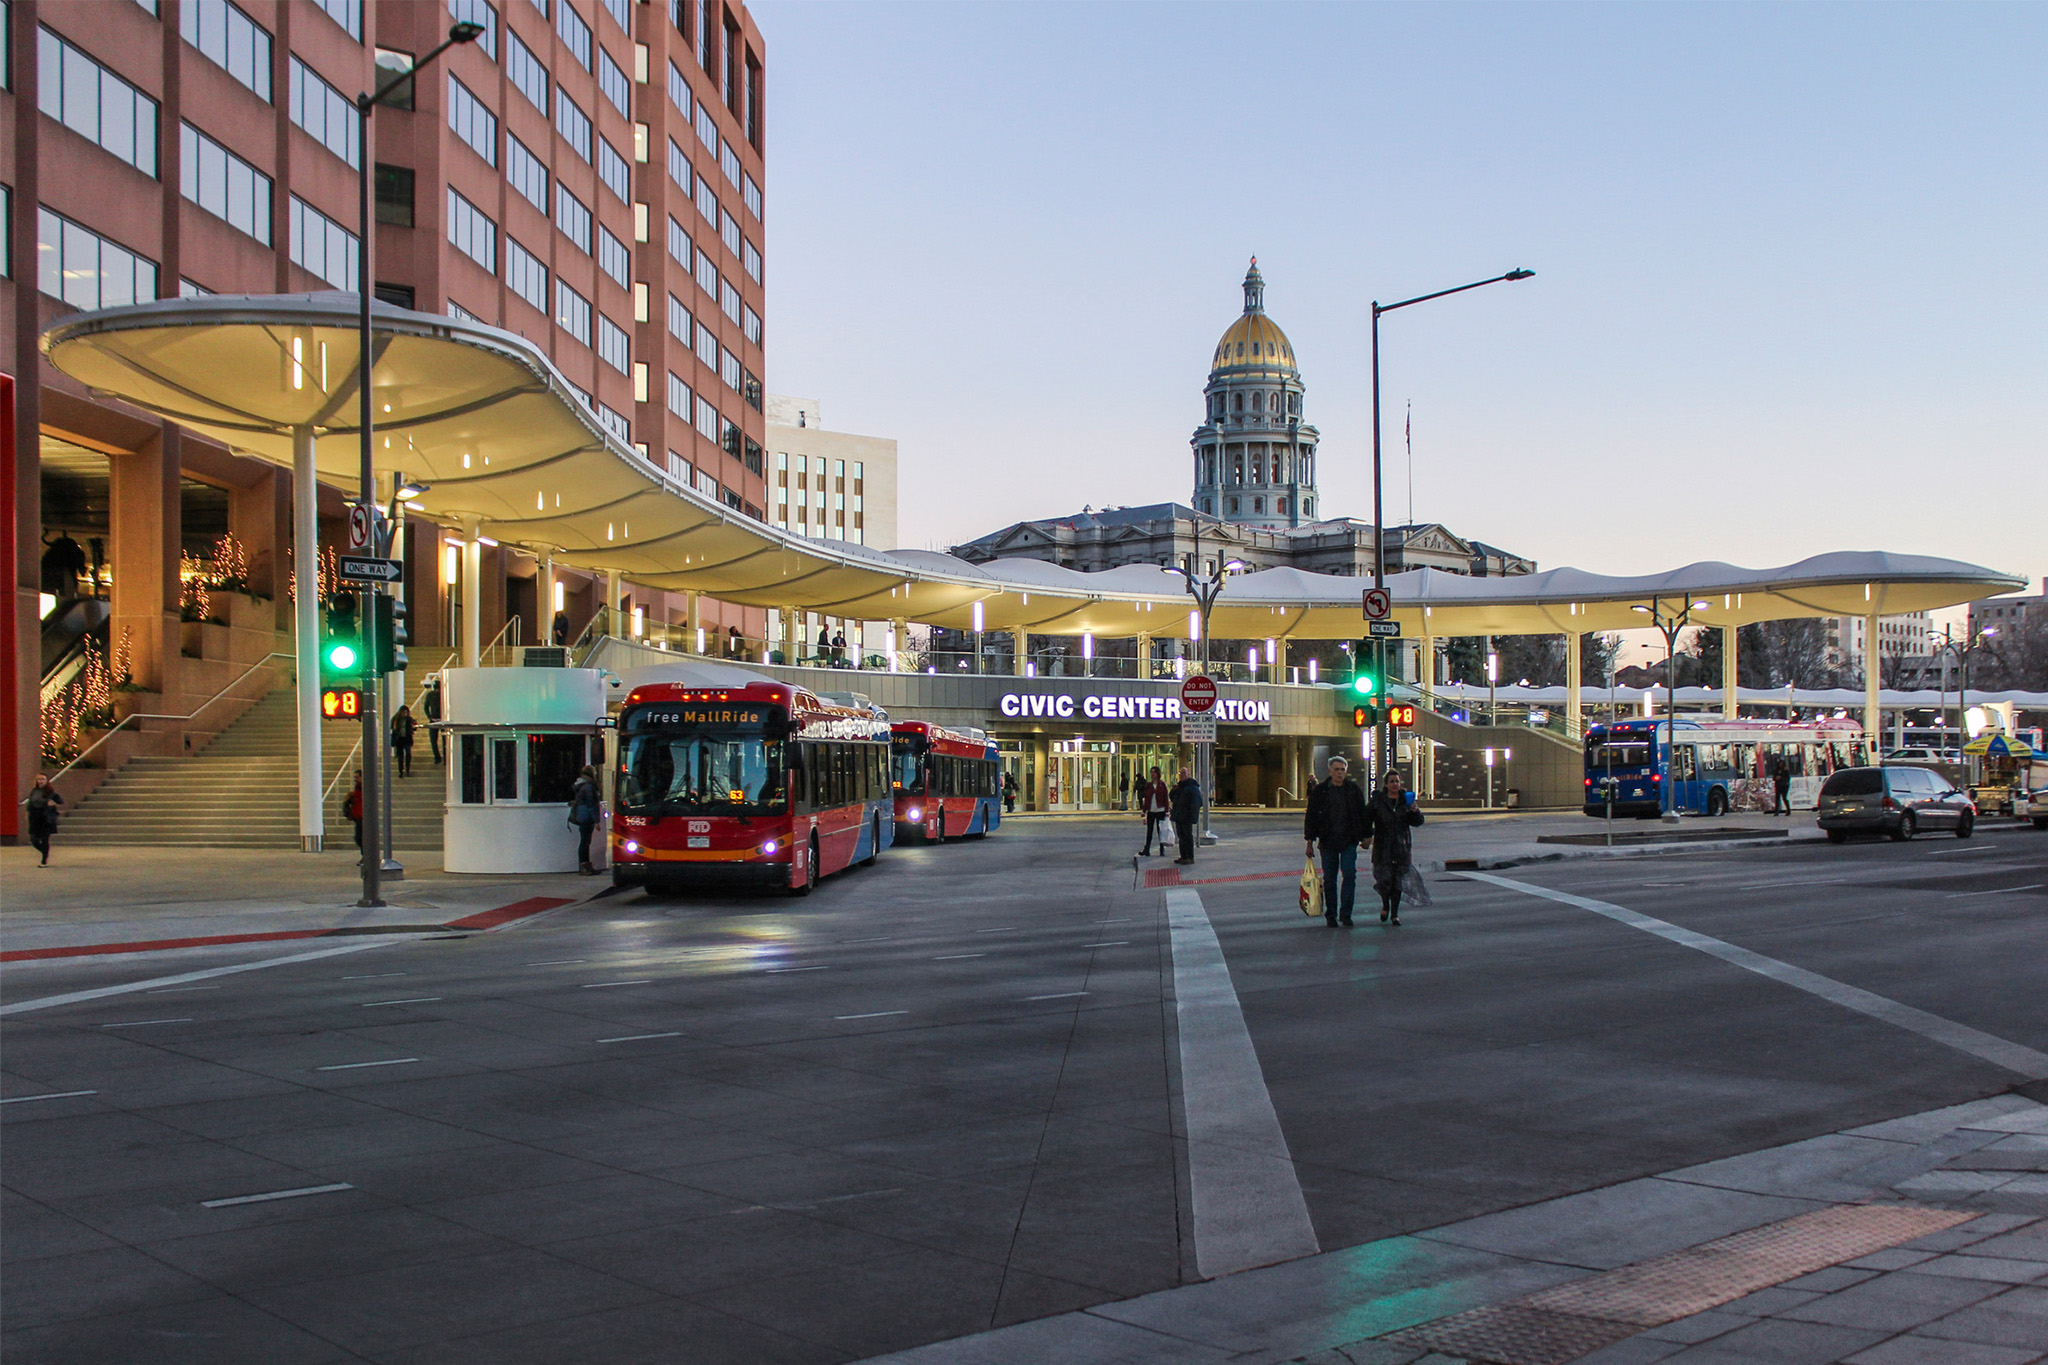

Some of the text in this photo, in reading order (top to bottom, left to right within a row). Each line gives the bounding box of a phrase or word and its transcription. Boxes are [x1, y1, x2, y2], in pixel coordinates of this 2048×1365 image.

[348, 564, 388, 576] ONE WAY
[1001, 694, 1073, 717] CIVIC
[1082, 695, 1181, 720] CENTER
[646, 710, 759, 723] free MallRide
[1403, 708, 1414, 724] 8
[890, 736, 910, 744] Ride
[1369, 725, 1377, 750] STATIO
[1369, 751, 1377, 779] CENTER
[688, 820, 710, 832] RTD
